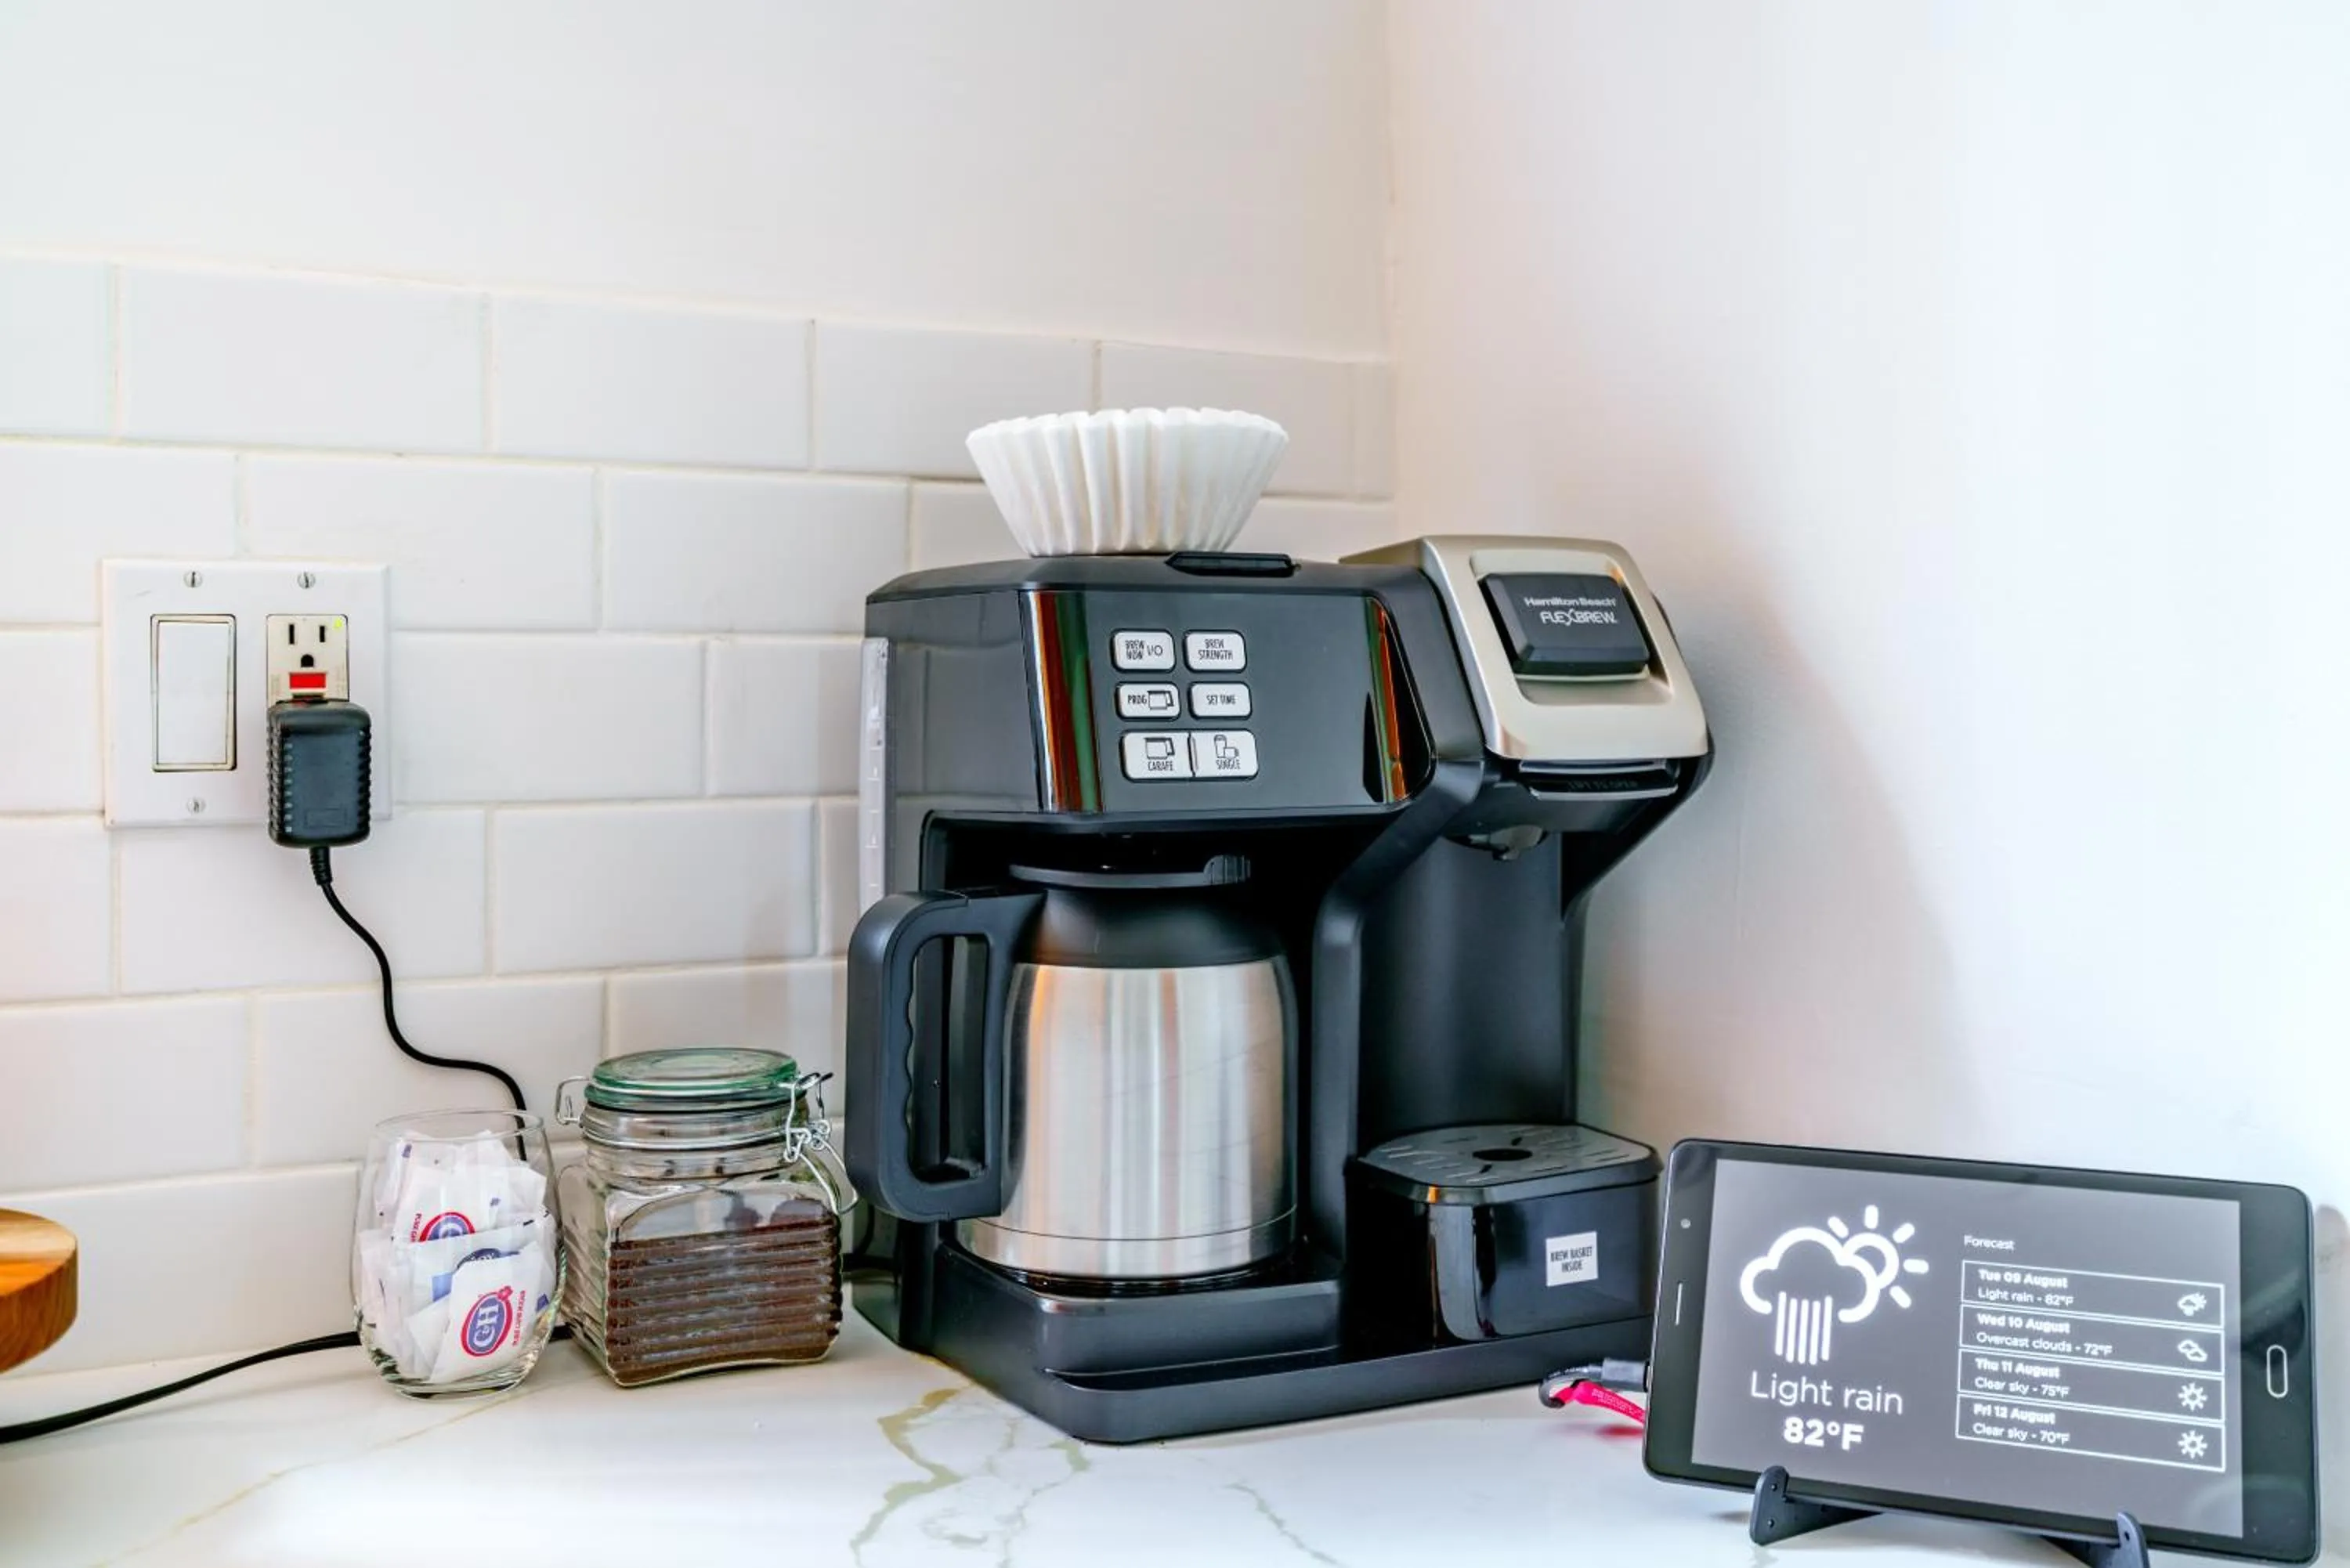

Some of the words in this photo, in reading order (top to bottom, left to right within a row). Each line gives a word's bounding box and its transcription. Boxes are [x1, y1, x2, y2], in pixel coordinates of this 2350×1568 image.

[1524, 597, 1579, 606] Hamilton
[1205, 639, 1224, 649] BREW
[1198, 650, 1234, 660] STRENGTH
[1148, 761, 1174, 771] CARAFE
[1216, 760, 1241, 770] SINGLE
[1964, 1235, 2016, 1252] Forecast
[1978, 1269, 2001, 1281] Tue
[2024, 1274, 2069, 1288] August
[1978, 1289, 2010, 1302] Light
[2012, 1292, 2034, 1303] rain
[1977, 1313, 2006, 1327] Wed
[2008, 1314, 2023, 1328] 10
[2026, 1317, 2071, 1335] August
[1977, 1331, 2030, 1349] Overcast
[2033, 1338, 2072, 1353] clouds
[1976, 1357, 2000, 1371] Thu
[2001, 1360, 2013, 1372] 11
[2016, 1361, 2060, 1378] August
[1751, 1371, 1833, 1407] Light
[1843, 1386, 1904, 1415] rain
[1976, 1377, 2006, 1391] Clear
[2008, 1380, 2030, 1395] sky
[1973, 1404, 1992, 1417] Fri
[2011, 1408, 2056, 1425] August
[1784, 1416, 1865, 1451] 82°F
[1973, 1423, 2005, 1436] Clear
[2007, 1426, 2028, 1442] sky
